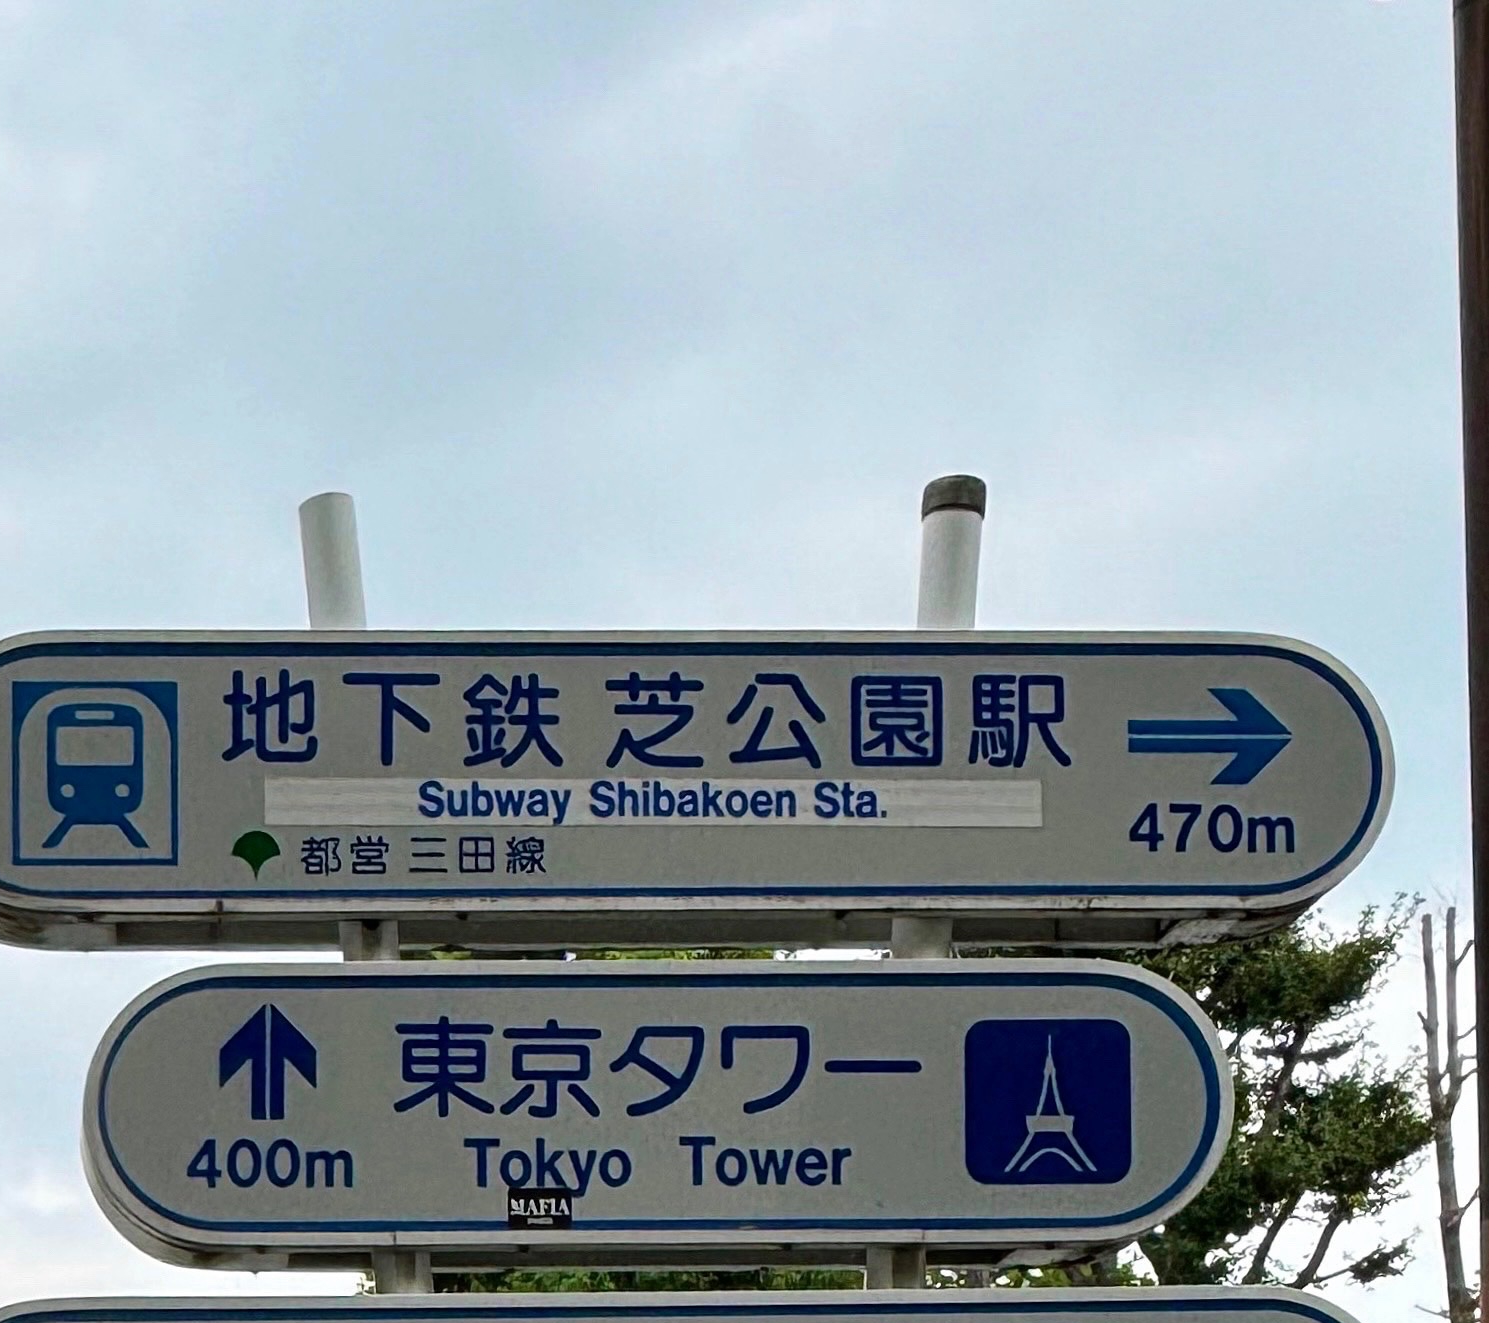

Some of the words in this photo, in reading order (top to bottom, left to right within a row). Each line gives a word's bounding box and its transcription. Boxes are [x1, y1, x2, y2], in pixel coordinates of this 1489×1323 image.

[418, 780, 571, 826] Subway
[589, 780, 797, 819] Shibakoen
[813, 780, 887, 819] Sta.
[1128, 803, 1296, 853] 470m
[393, 1015, 922, 1118] 東京タワー
[186, 1138, 354, 1188] 400m
[463, 1137, 632, 1198] Tokyo
[678, 1135, 852, 1186] Tower
[510, 1198, 571, 1216] MAFIA
